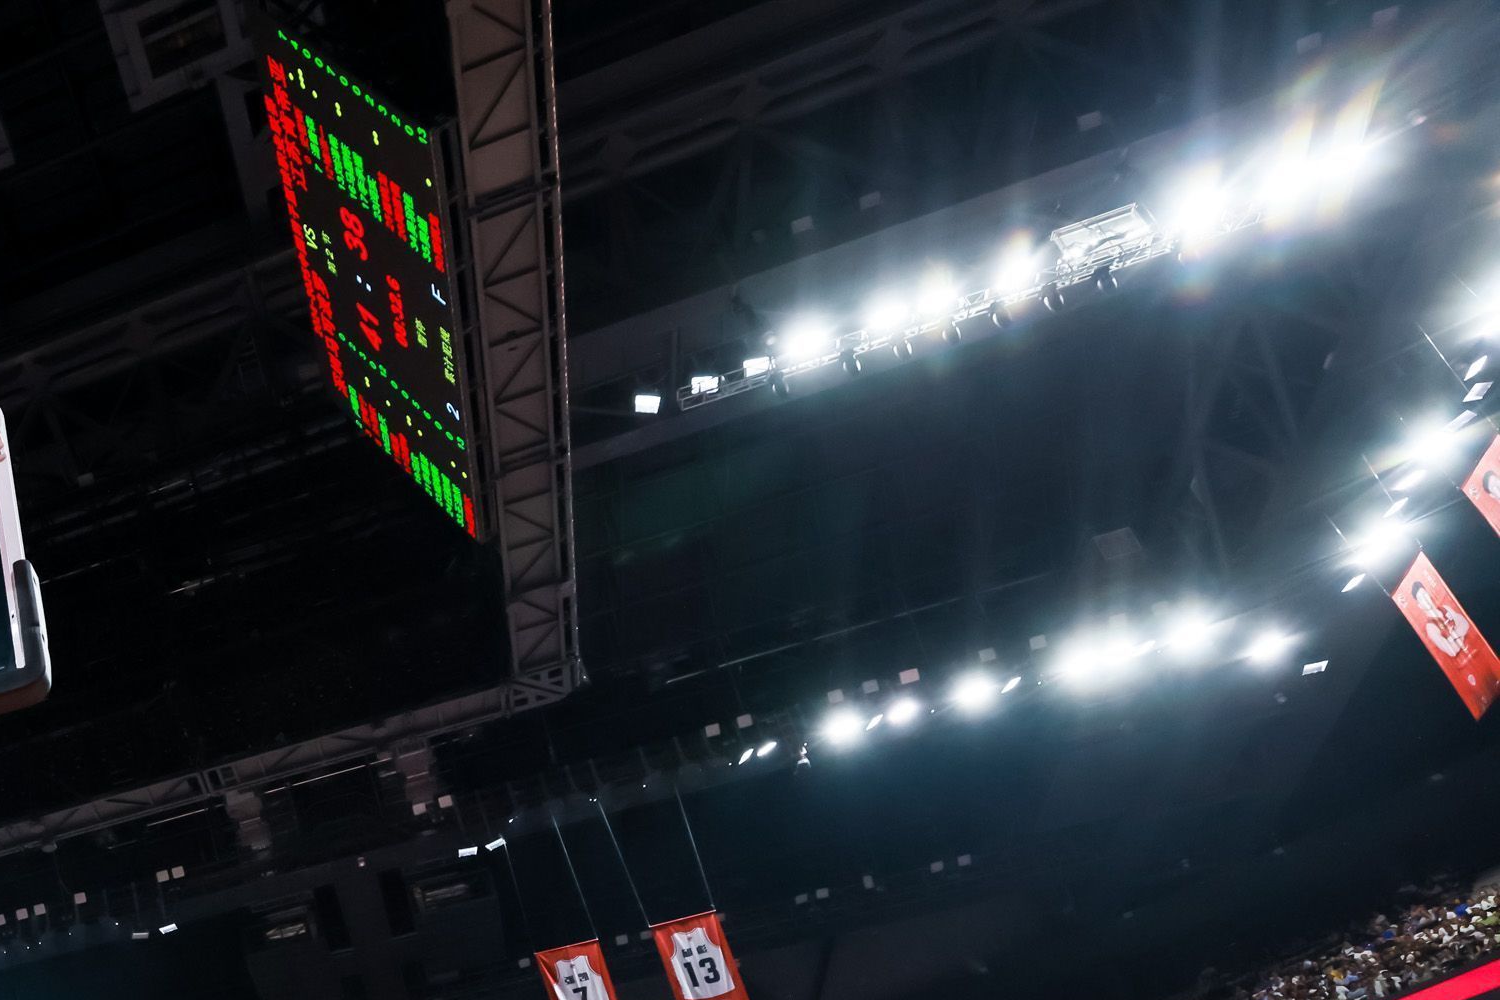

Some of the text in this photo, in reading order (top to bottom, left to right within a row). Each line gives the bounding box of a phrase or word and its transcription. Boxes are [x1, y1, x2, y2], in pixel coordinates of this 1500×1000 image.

[303, 223, 318, 250] VS
[339, 206, 383, 352] 41 38
[431, 283, 447, 306] F
[446, 402, 460, 421] 2
[683, 957, 721, 988] 13
